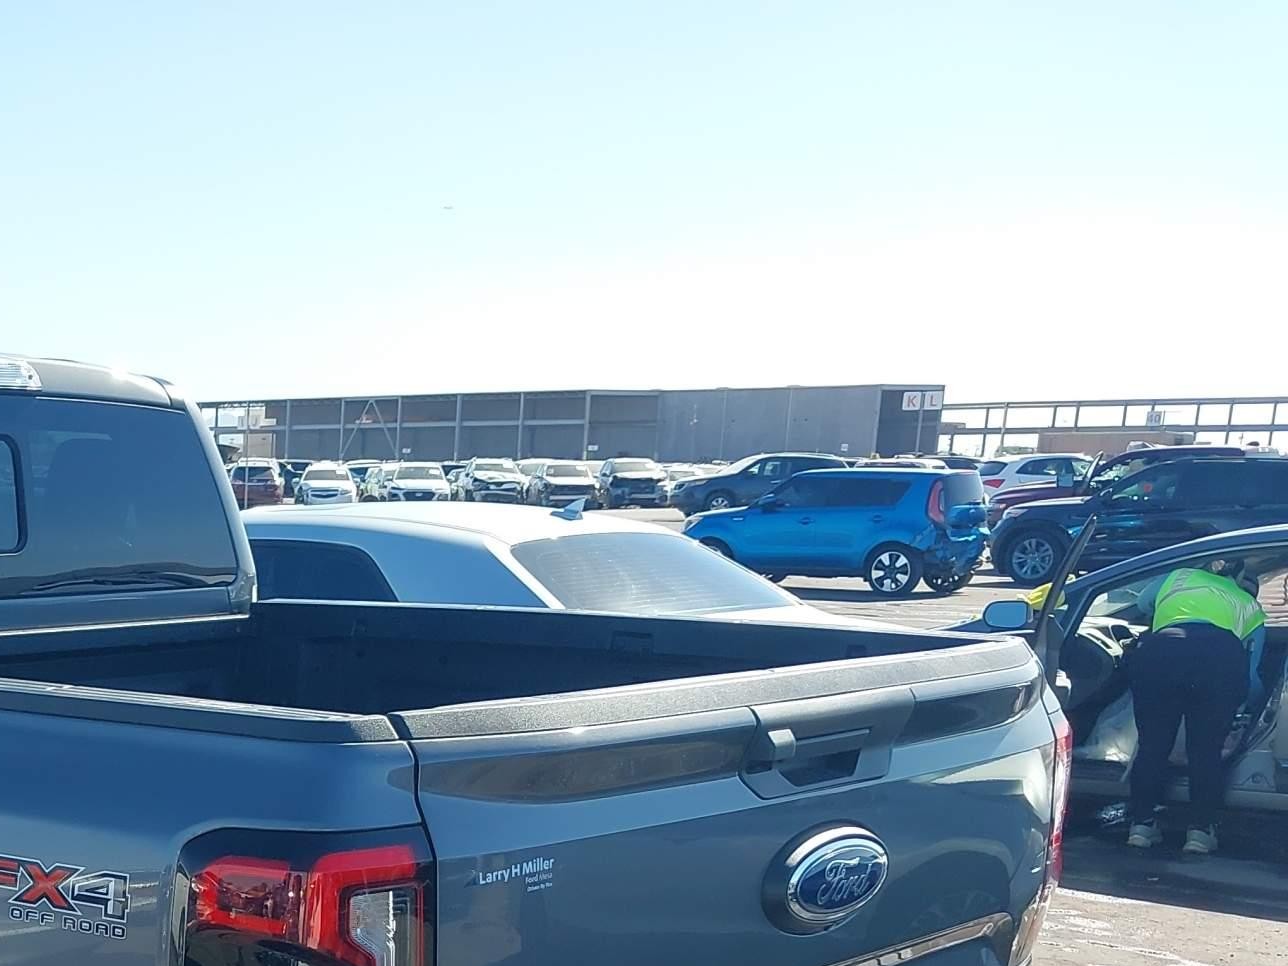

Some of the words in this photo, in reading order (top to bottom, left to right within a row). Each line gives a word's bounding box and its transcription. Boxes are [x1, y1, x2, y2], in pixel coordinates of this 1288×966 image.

[907, 395, 917, 408] K
[929, 395, 937, 407] L
[479, 868, 510, 885] Larry
[512, 864, 521, 877] H
[522, 857, 555, 875] Miller
[817, 857, 872, 905] Ford
[9, 907, 55, 925] OFF
[63, 916, 127, 940] ROAD
